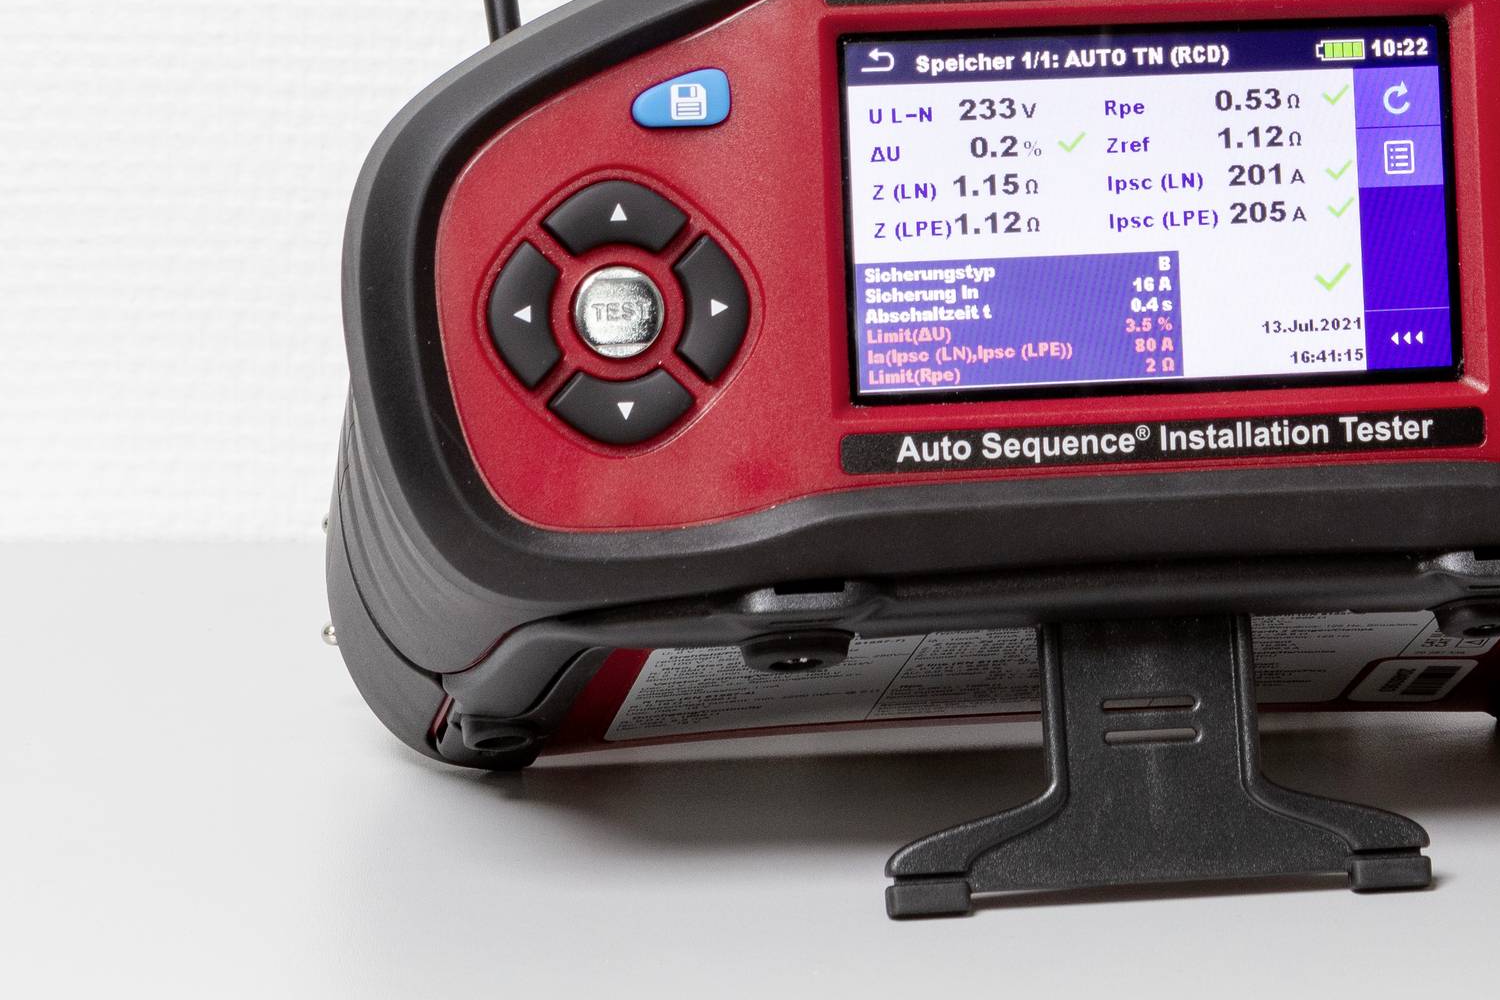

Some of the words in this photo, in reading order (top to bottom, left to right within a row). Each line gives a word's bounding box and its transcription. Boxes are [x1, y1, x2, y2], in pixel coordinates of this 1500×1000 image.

[1372, 39, 1427, 57] 10:22
[916, 54, 1014, 76] Speicher
[1022, 52, 1059, 69] 1/1:
[1064, 50, 1126, 68] AUTO
[1133, 49, 1163, 66] TN
[1171, 46, 1229, 67] (RCD)
[1105, 100, 1145, 118] Rpe
[1215, 88, 1282, 111] 0.53
[869, 108, 882, 124] U
[959, 98, 1016, 121] 233
[970, 136, 1018, 158] 0.2
[1107, 137, 1150, 153] Zref
[1218, 126, 1283, 149] 1.12
[1108, 175, 1152, 194] Ipsc
[1161, 172, 1203, 192] (LN)
[1228, 164, 1282, 186] 201
[873, 185, 884, 200] Z
[894, 184, 936, 203] (LN)
[953, 174, 1020, 197] 1.15
[1109, 213, 1154, 232] Ipsc
[1163, 210, 1218, 230] (LPE)
[1230, 202, 1286, 224] 205
[874, 224, 886, 238] Z
[895, 220, 952, 241] (LPE)
[955, 212, 1021, 235] 1.12
[1159, 256, 1170, 271] B
[865, 265, 995, 283] Sicherungstyp
[1134, 277, 1154, 292] 16
[866, 287, 956, 305] Sicherung
[1131, 299, 1158, 312] 0.4
[591, 301, 651, 321] TEST
[866, 306, 979, 324] Abschaltzeit
[1126, 318, 1151, 332] 3.5
[1262, 317, 1361, 334] 13.Jul.2021
[1135, 338, 1156, 352] 80
[1290, 348, 1363, 364] 16:41:15
[869, 367, 960, 386] Limit(Rpe)
[897, 434, 972, 463] Auto
[1160, 420, 1329, 451] Installation
[1339, 416, 1433, 443] Tester
